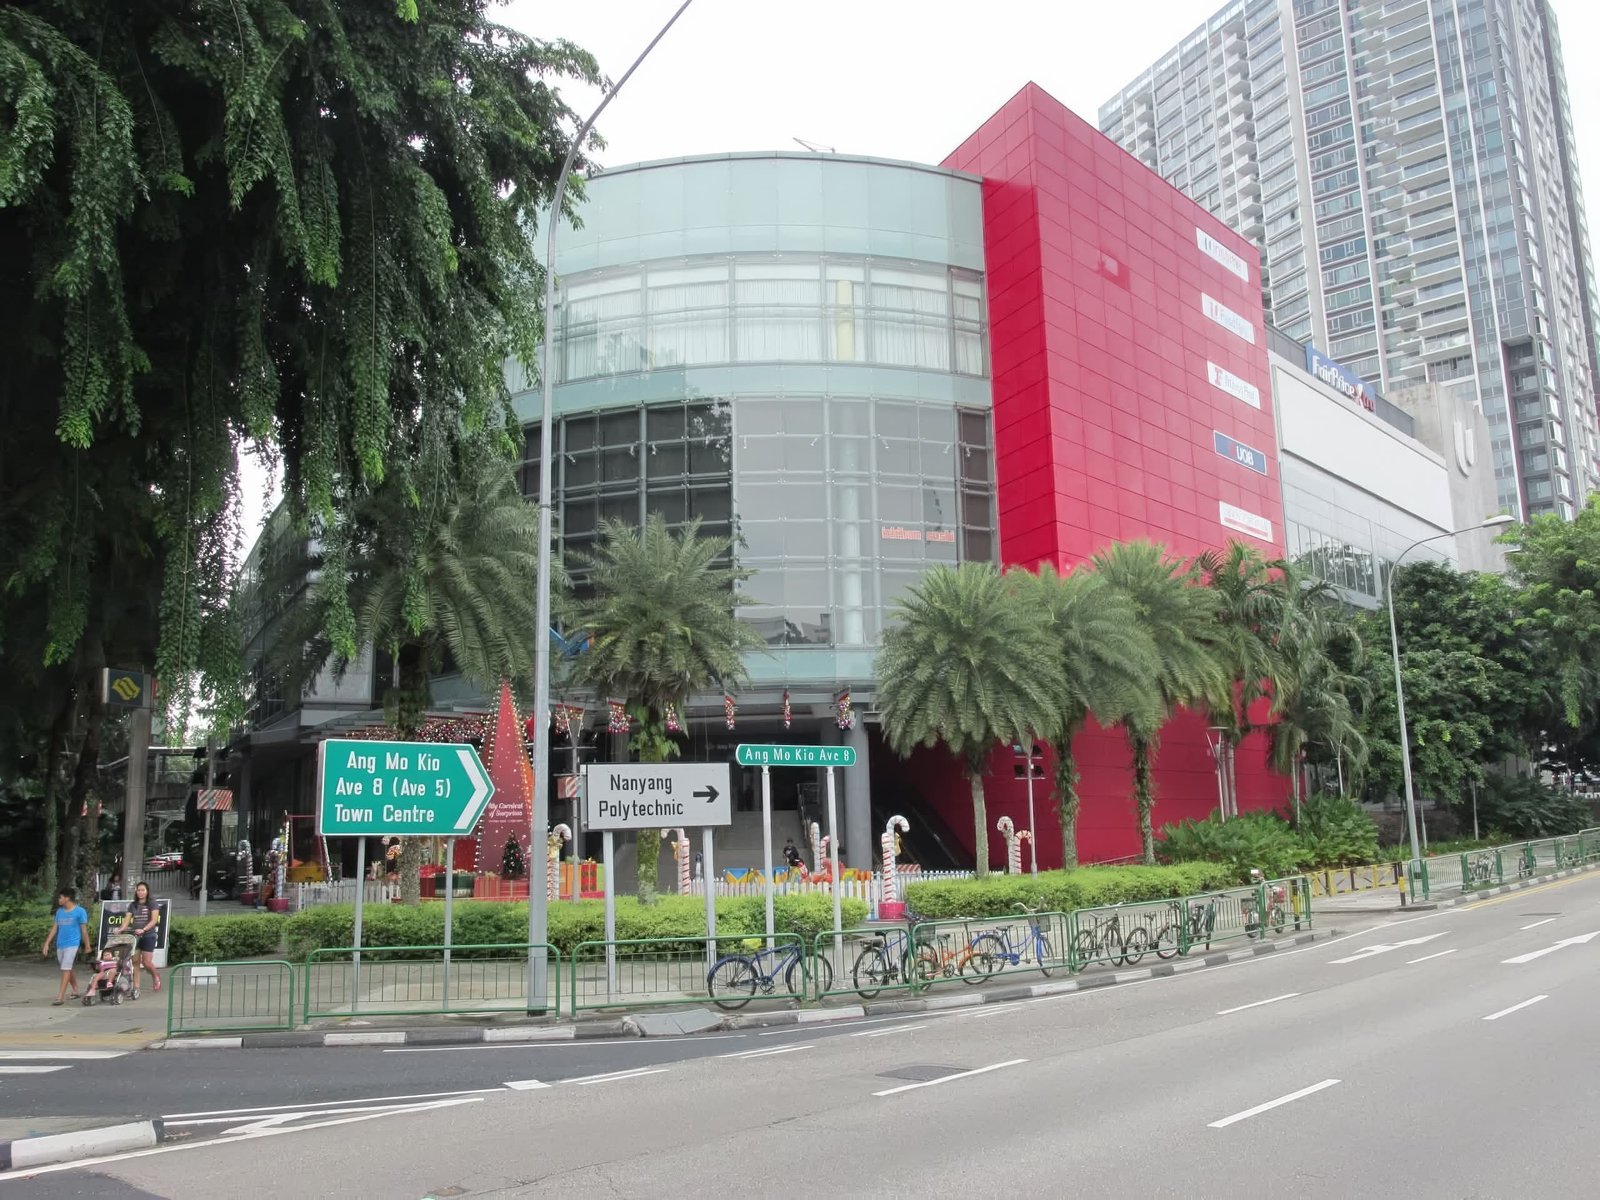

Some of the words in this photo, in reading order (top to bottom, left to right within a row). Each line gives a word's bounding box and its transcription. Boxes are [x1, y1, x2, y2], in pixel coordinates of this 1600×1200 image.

[1312, 355, 1355, 398] FairPrice
[1236, 445, 1254, 466] UOB
[346, 751, 376, 774] Ang
[385, 752, 409, 771] Mo
[417, 753, 441, 772] Kio
[745, 747, 769, 763] Ang
[773, 747, 790, 761] Mo
[795, 748, 814, 761] Kio
[820, 749, 839, 761] Ave
[843, 749, 850, 761] 8
[335, 777, 363, 796] Ave
[372, 777, 383, 796] 8
[392, 776, 426, 798] (Ave
[435, 778, 451, 798] 5)
[610, 773, 672, 795] Nanyang
[335, 804, 373, 823] Town
[383, 804, 435, 823] Centre
[599, 798, 684, 821] Polytechnic
